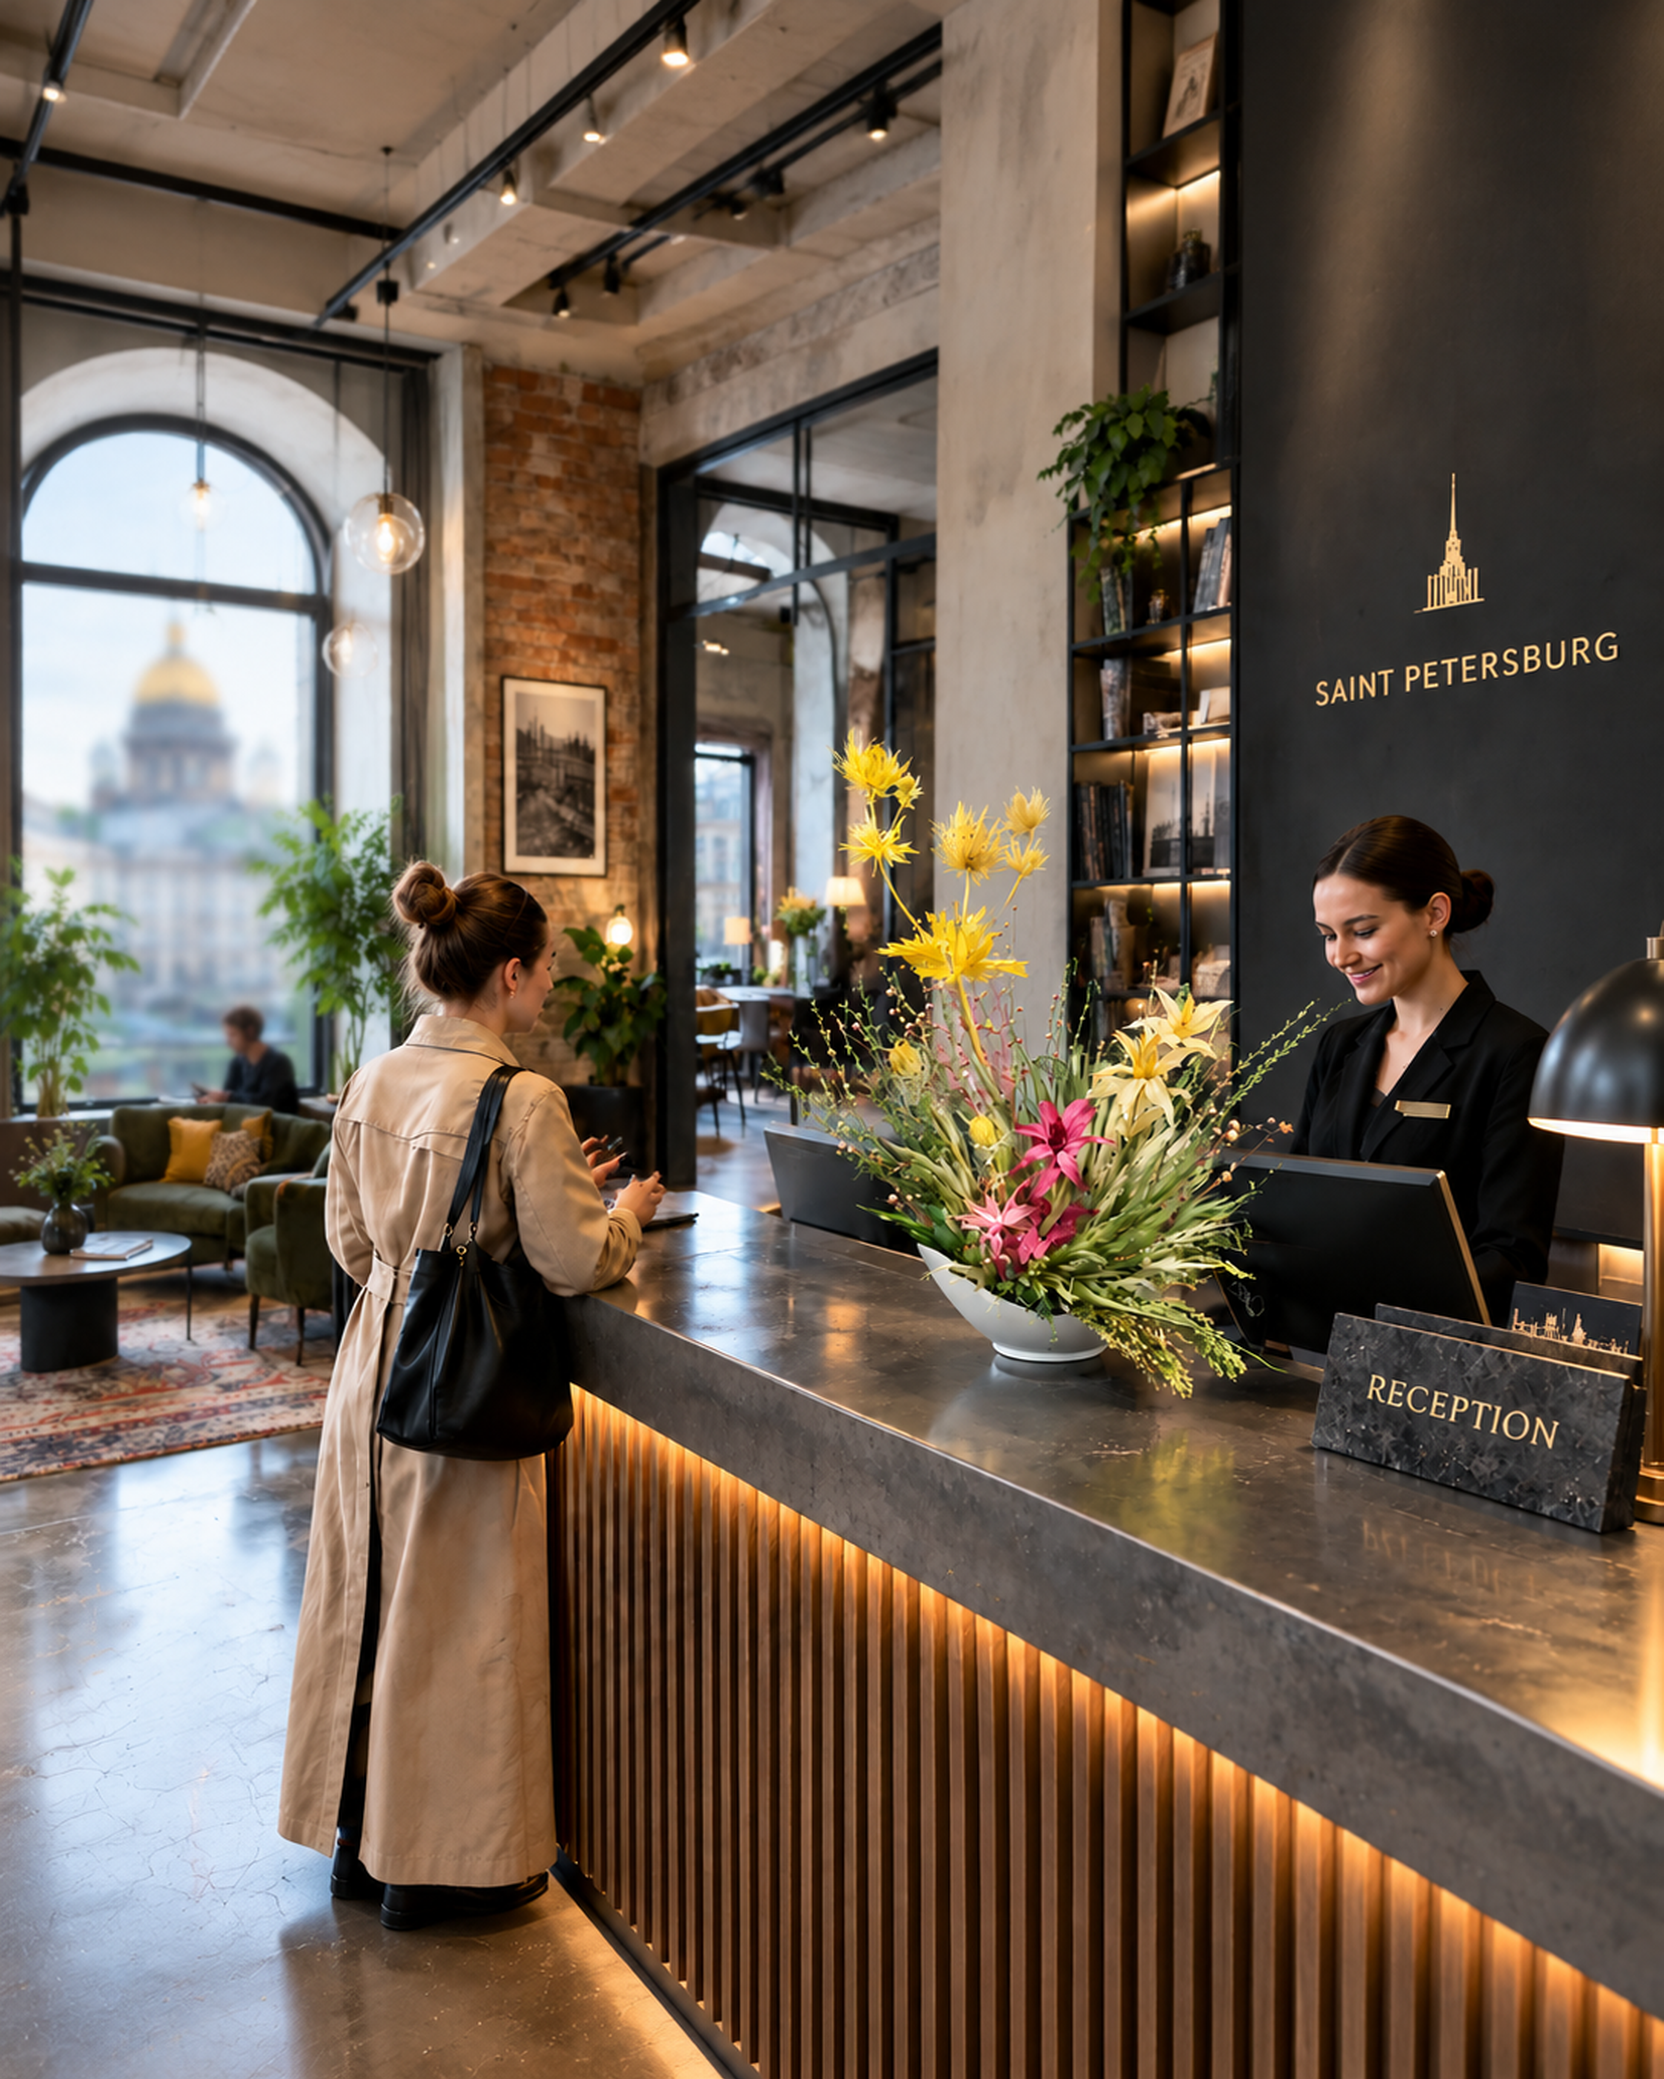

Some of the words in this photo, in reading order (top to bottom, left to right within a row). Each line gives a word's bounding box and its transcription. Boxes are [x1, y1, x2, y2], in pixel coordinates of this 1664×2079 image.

[1315, 668, 1395, 707] SAINT
[1405, 631, 1619, 692] PETERSBURG
[1366, 1374, 1560, 1450] RECEPTION
